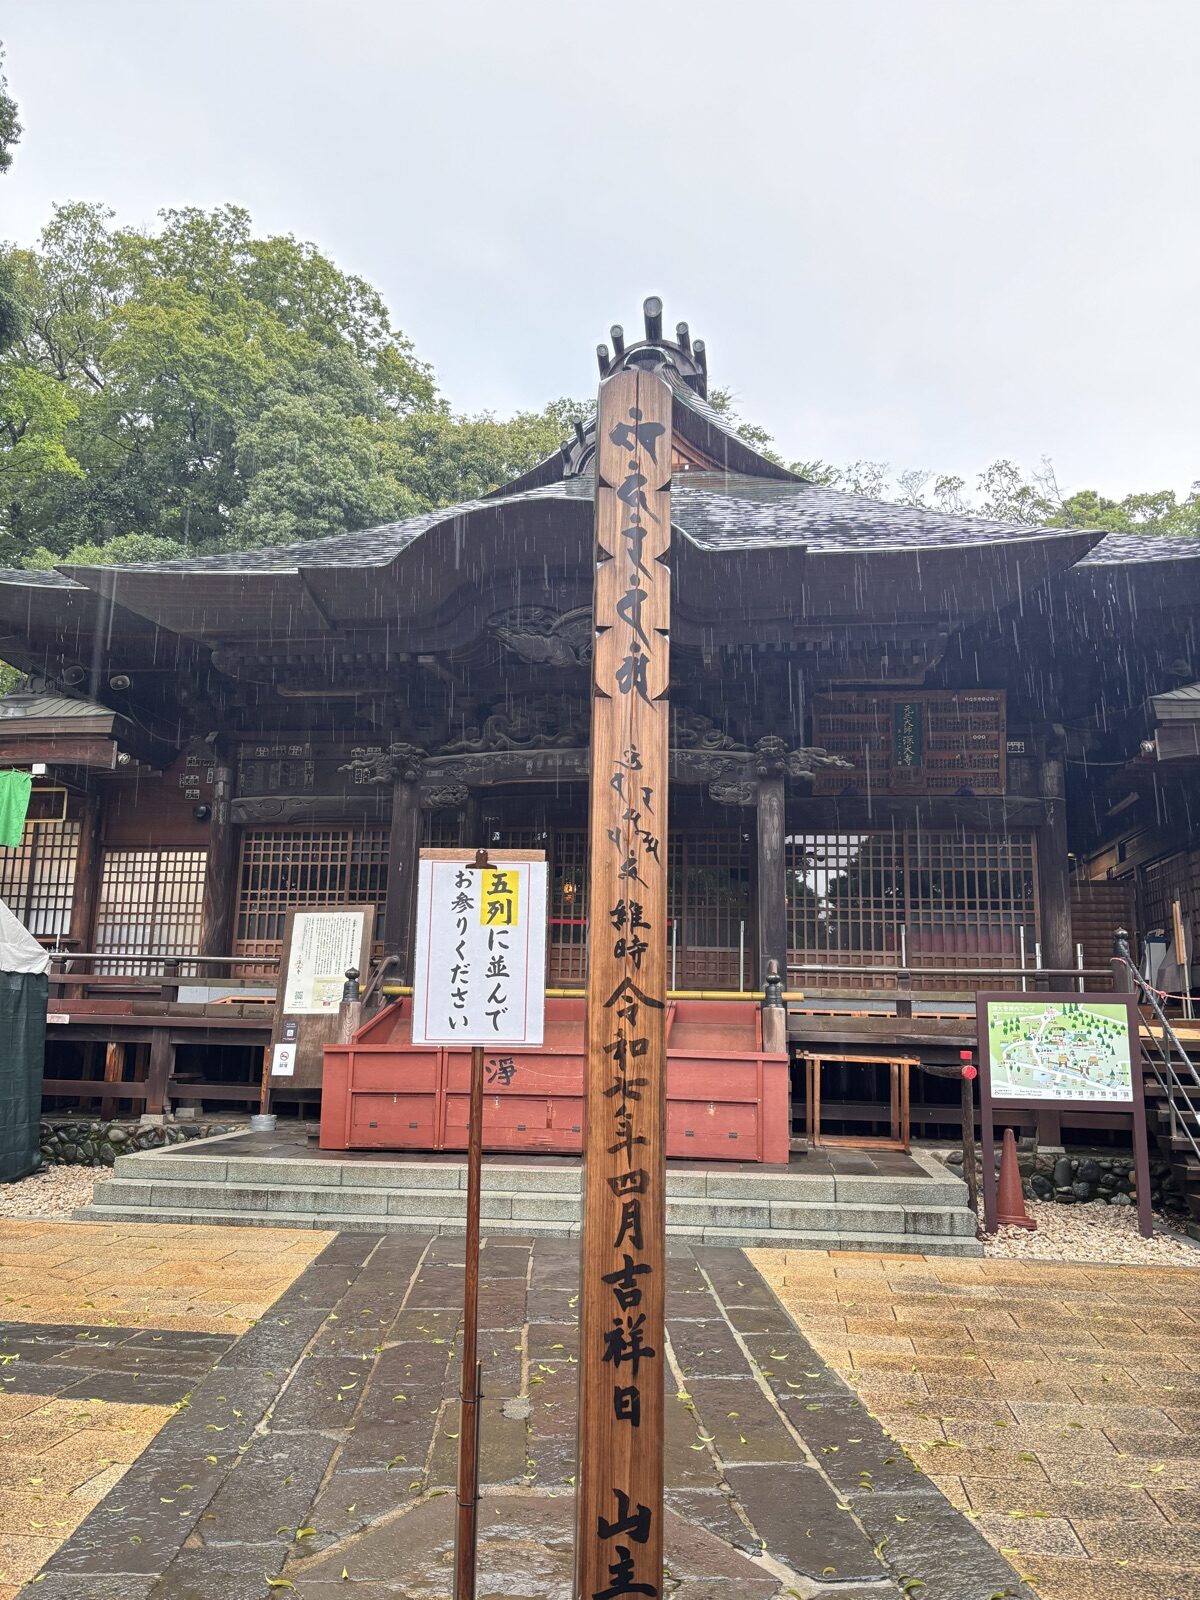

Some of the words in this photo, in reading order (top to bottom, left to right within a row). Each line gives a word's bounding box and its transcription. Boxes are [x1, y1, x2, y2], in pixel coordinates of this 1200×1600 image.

[448, 869, 474, 1030] お参りください
[484, 872, 513, 1032] 五列に並んで
[592, 1487, 658, 1600] 山主
